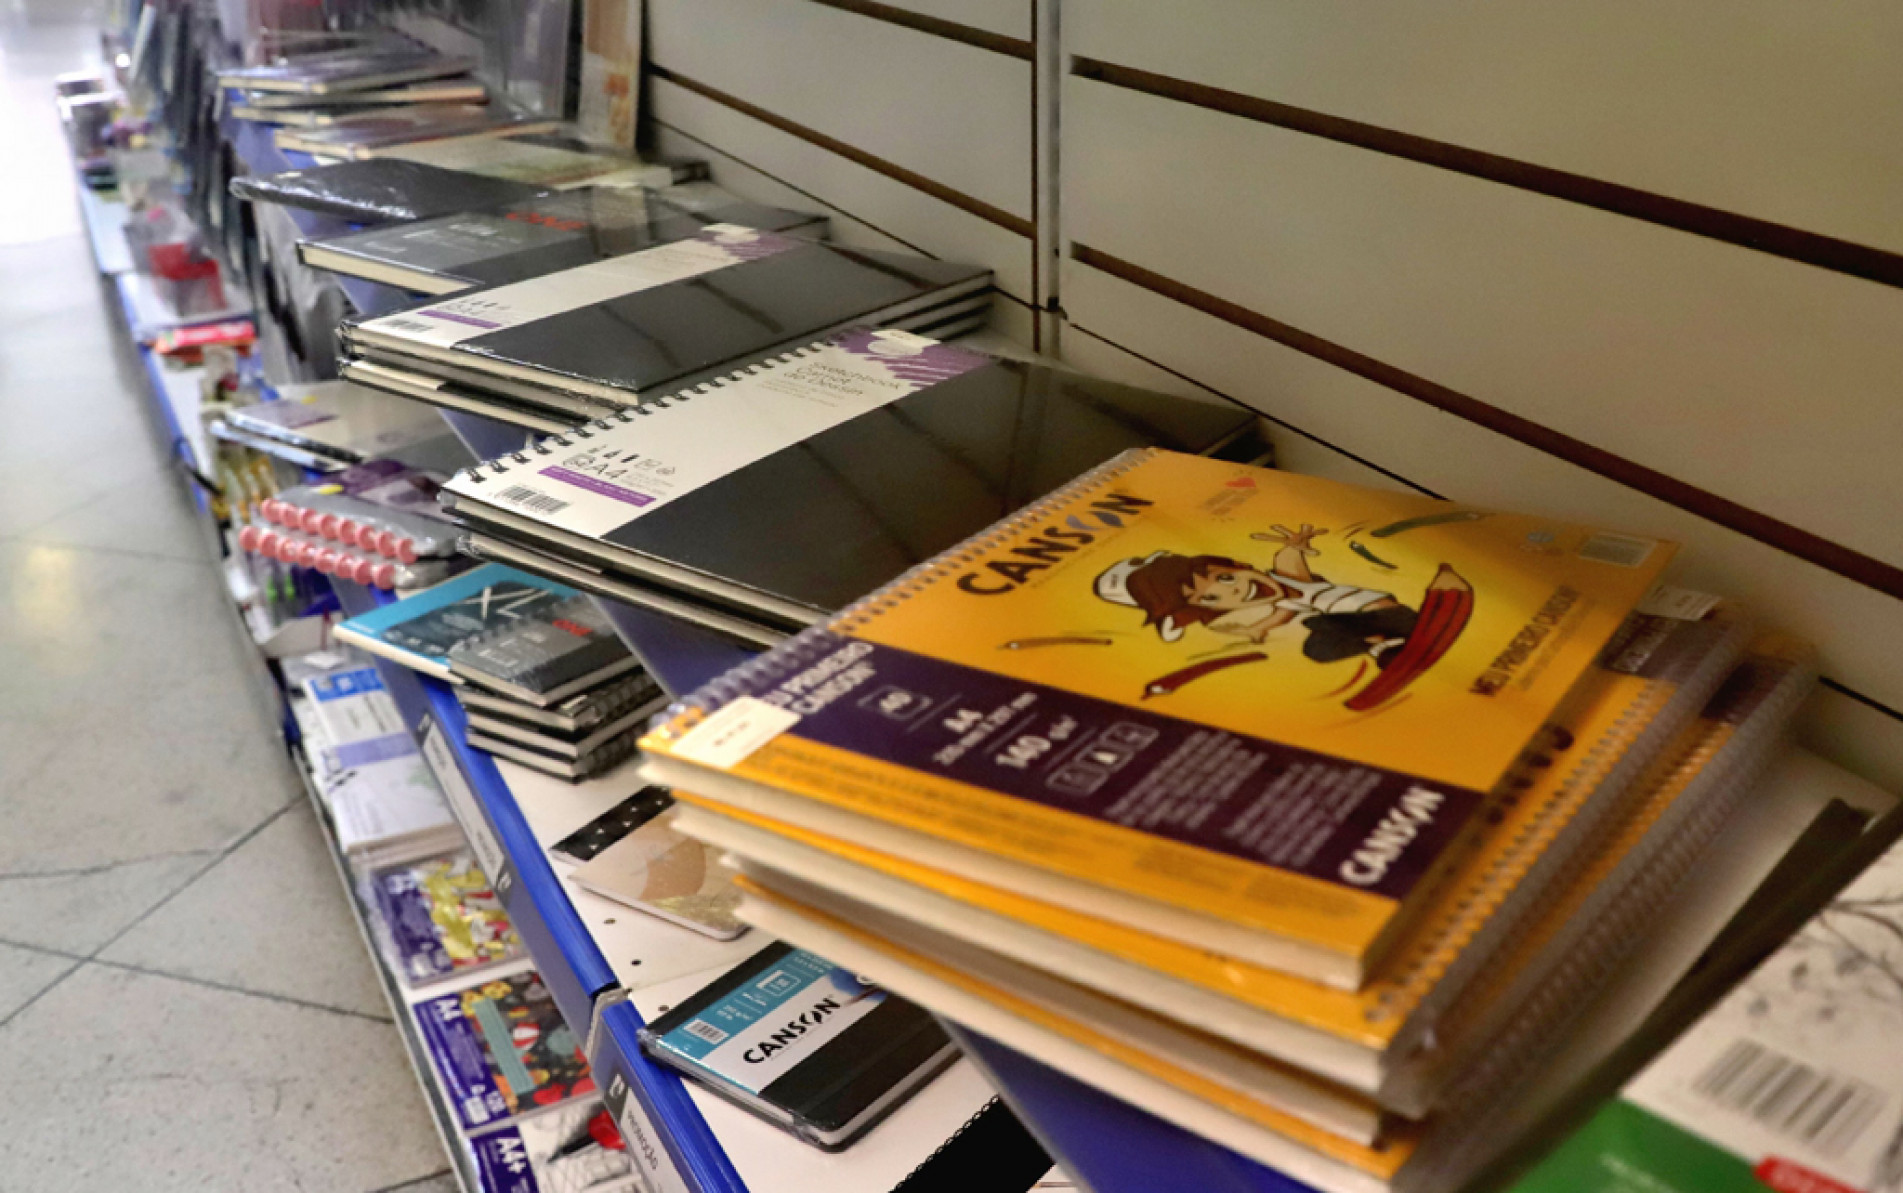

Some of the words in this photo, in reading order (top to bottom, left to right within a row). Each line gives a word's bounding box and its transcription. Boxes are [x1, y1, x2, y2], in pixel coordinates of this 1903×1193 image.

[956, 492, 1155, 596] CANSON
[941, 708, 984, 735] A4
[995, 735, 1052, 769] 140
[1339, 785, 1446, 887] CANSON
[742, 996, 842, 1065] CANSON
[496, 1138, 527, 1174] A4+
